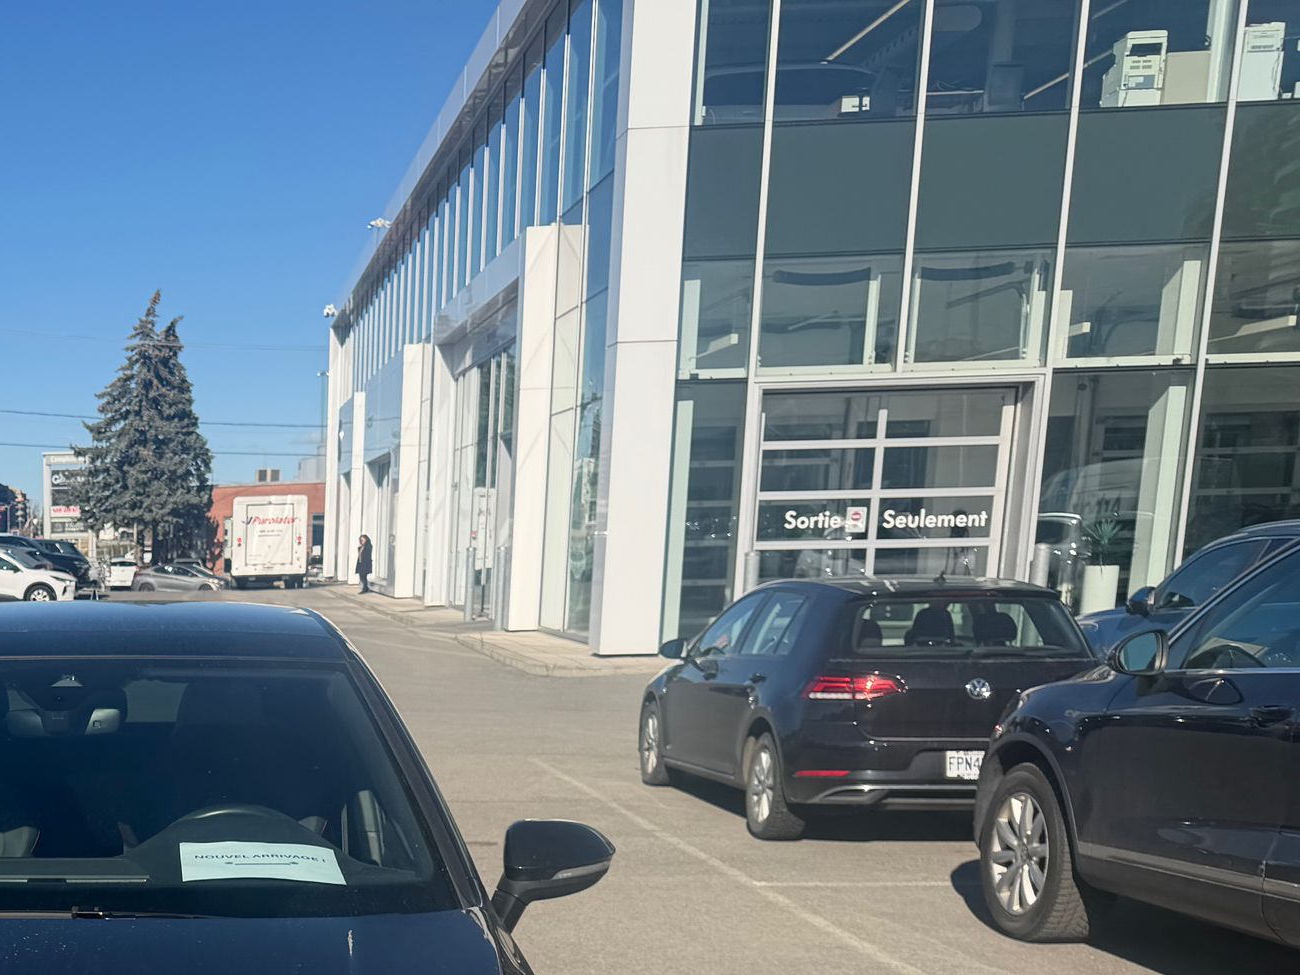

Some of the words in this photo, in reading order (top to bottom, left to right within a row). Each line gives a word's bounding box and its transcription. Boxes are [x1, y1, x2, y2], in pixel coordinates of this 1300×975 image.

[784, 510, 842, 529] Sortie
[882, 508, 989, 529] Seulement
[252, 854, 319, 862] ARRIVAGE
